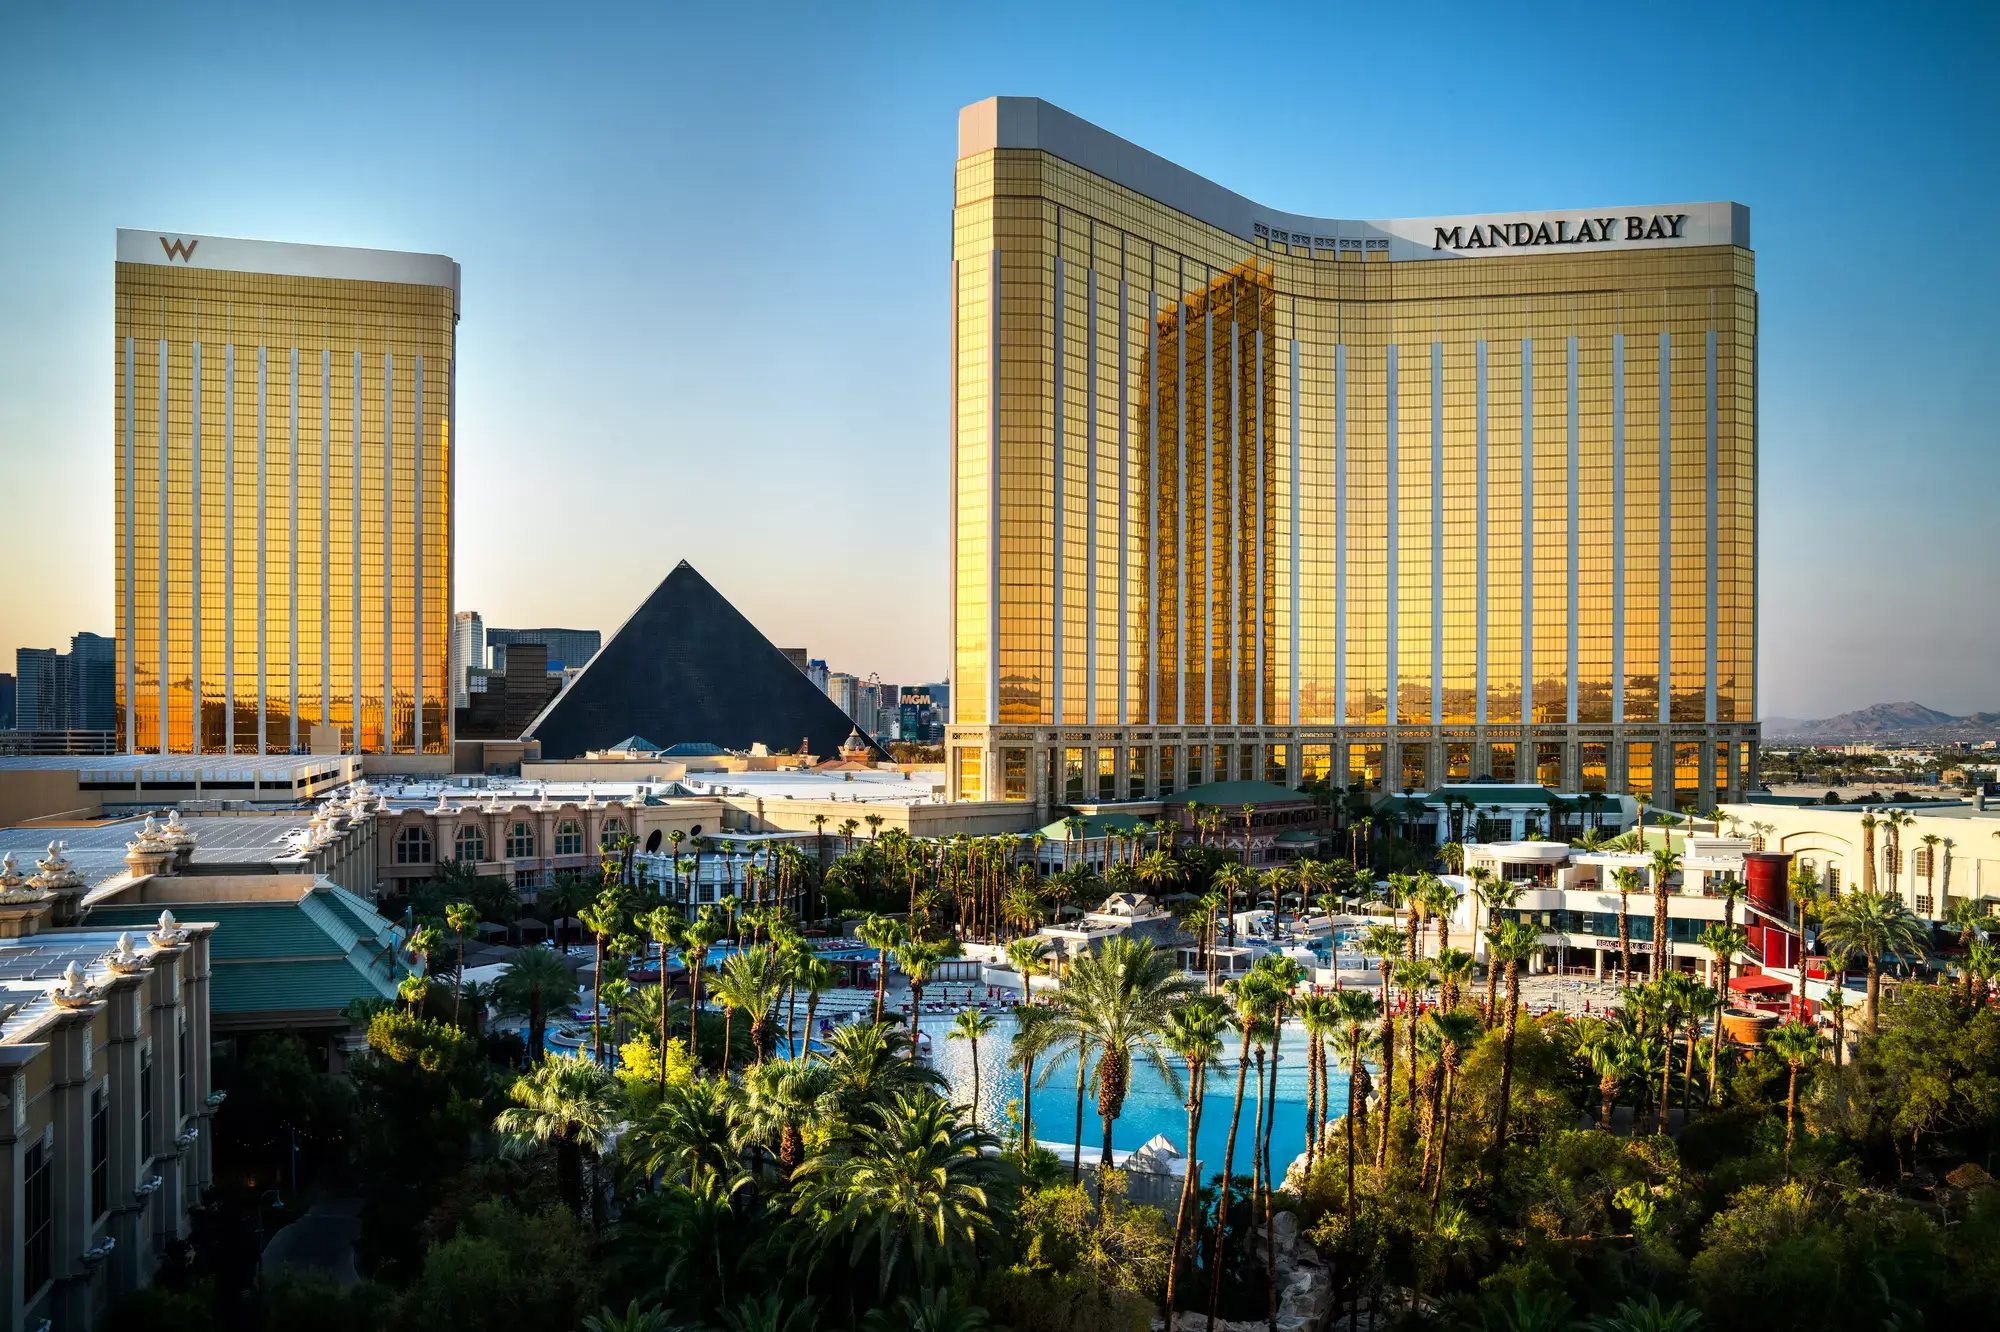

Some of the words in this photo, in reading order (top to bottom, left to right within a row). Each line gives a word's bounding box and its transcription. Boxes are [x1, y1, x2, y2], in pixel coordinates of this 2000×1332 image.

[1432, 218, 1616, 250] MANDALAY
[1625, 214, 1686, 241] BAY
[159, 236, 198, 263] W
[901, 694, 931, 705] MGM
[1597, 940, 1620, 948] BEACH
